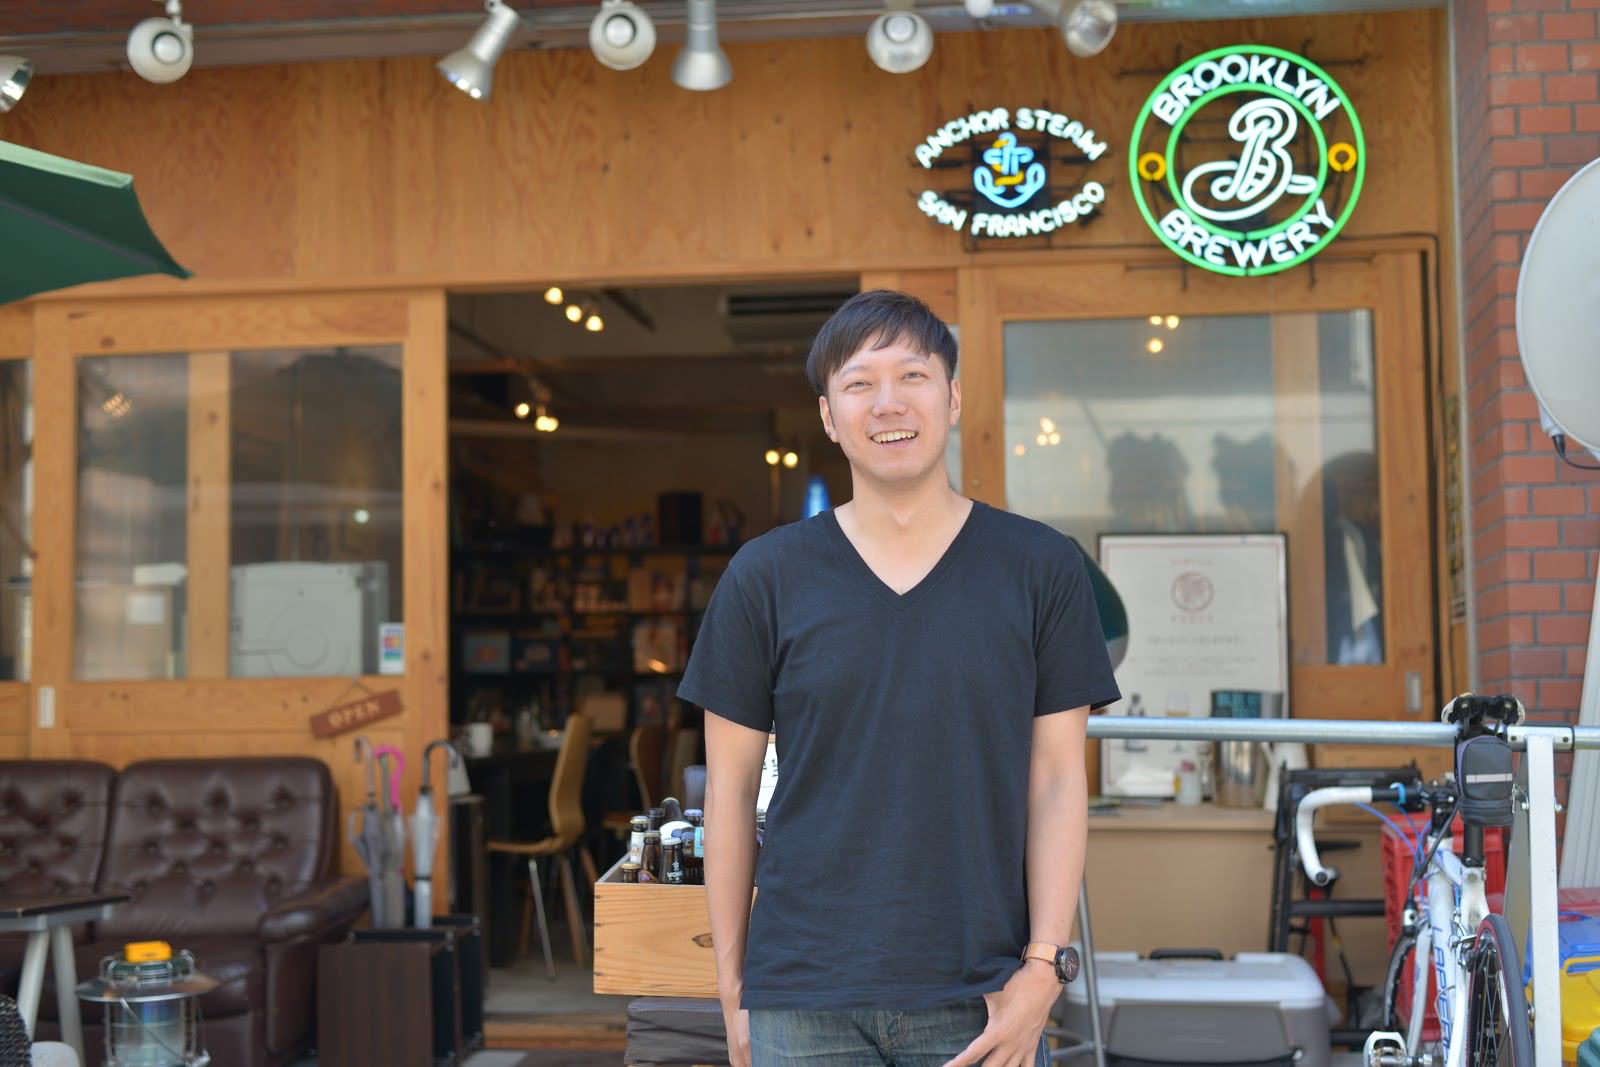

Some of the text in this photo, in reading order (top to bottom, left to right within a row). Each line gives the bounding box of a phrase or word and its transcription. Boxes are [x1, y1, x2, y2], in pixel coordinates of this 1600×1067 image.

[1151, 54, 1341, 126] BROOKLYN
[915, 107, 1108, 169] ANCHOR STEAM
[917, 181, 1105, 237] SAN FRANCISCO
[1159, 198, 1335, 268] BREWERY
[327, 700, 380, 728] OPEN
